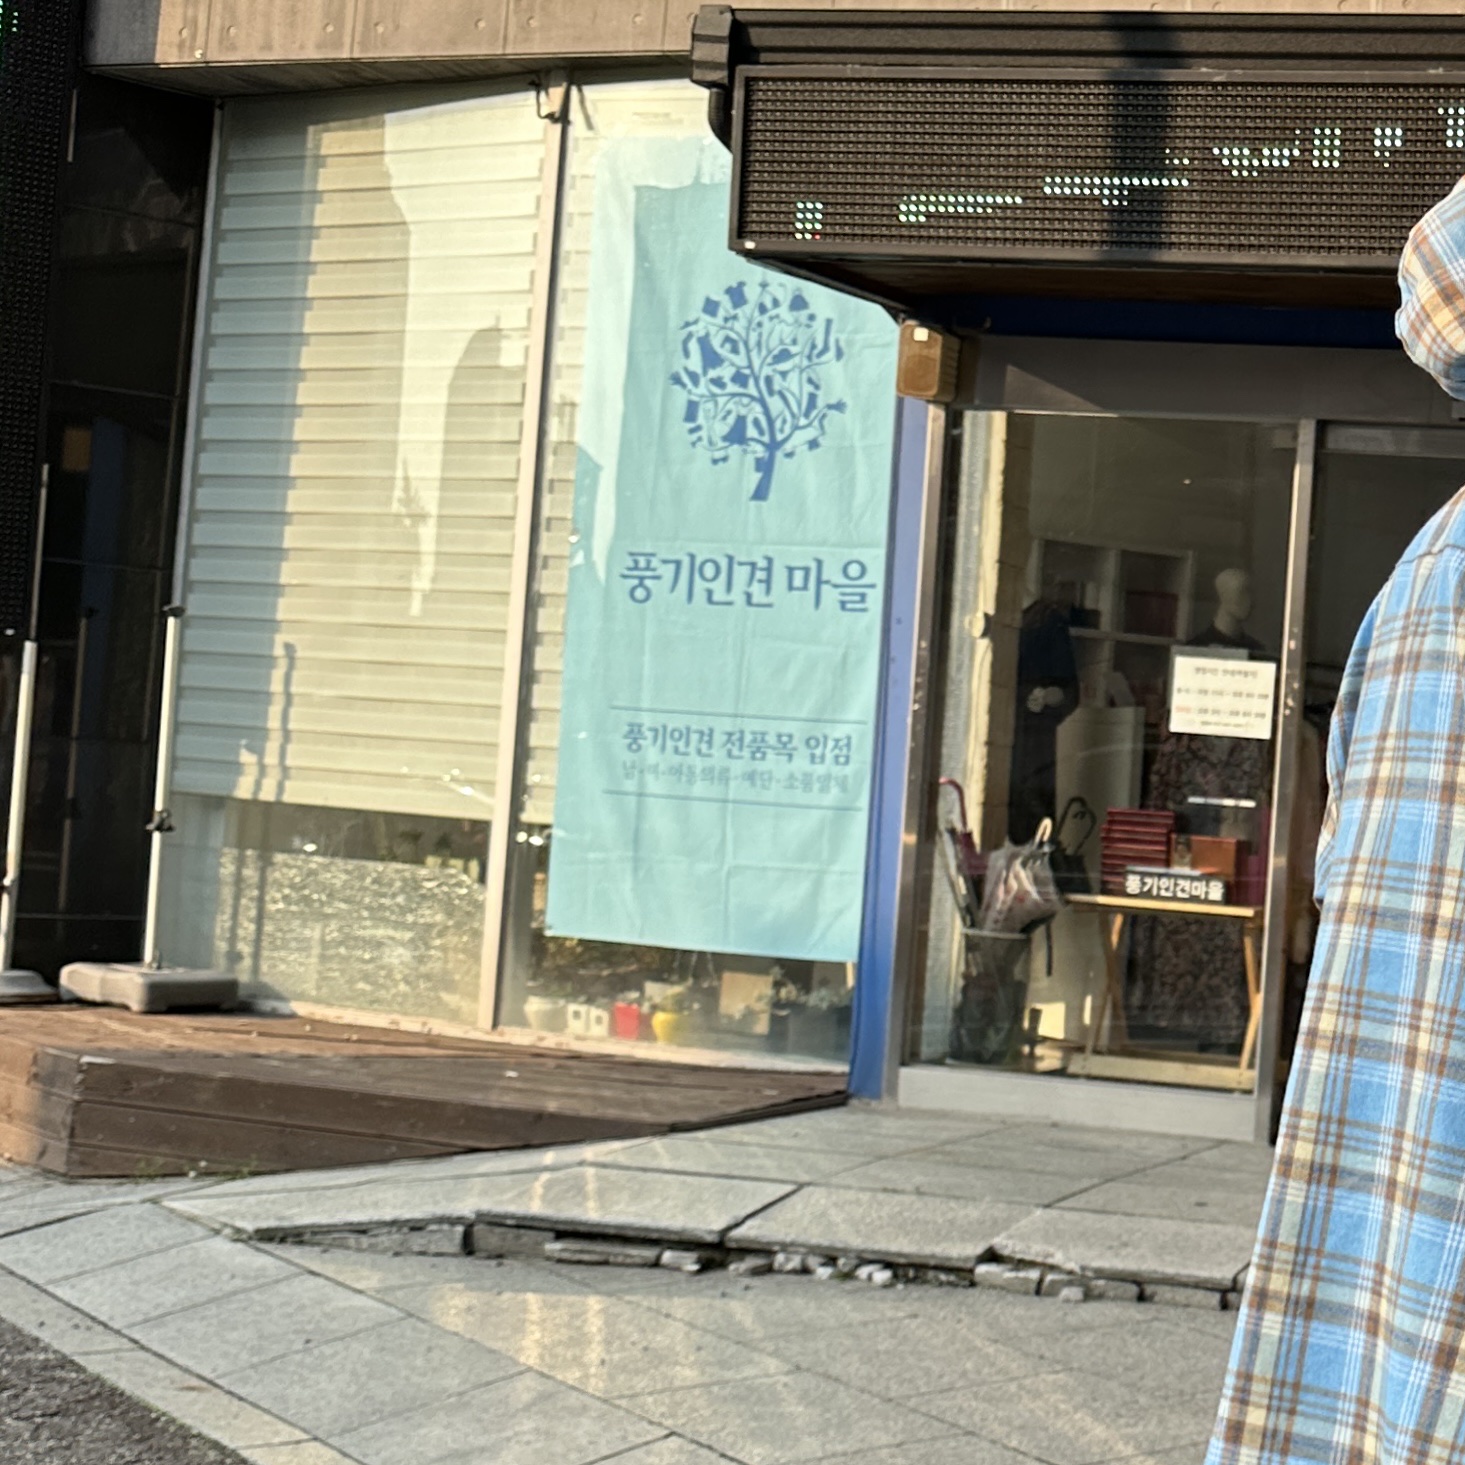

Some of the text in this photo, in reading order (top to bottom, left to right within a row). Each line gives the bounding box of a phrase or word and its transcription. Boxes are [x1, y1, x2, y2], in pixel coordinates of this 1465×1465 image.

[620, 551, 878, 612] 풍기인견 마을
[622, 722, 853, 766] 풍기인견 전품목 입점
[1125, 873, 1224, 901] 풍기인견마을
